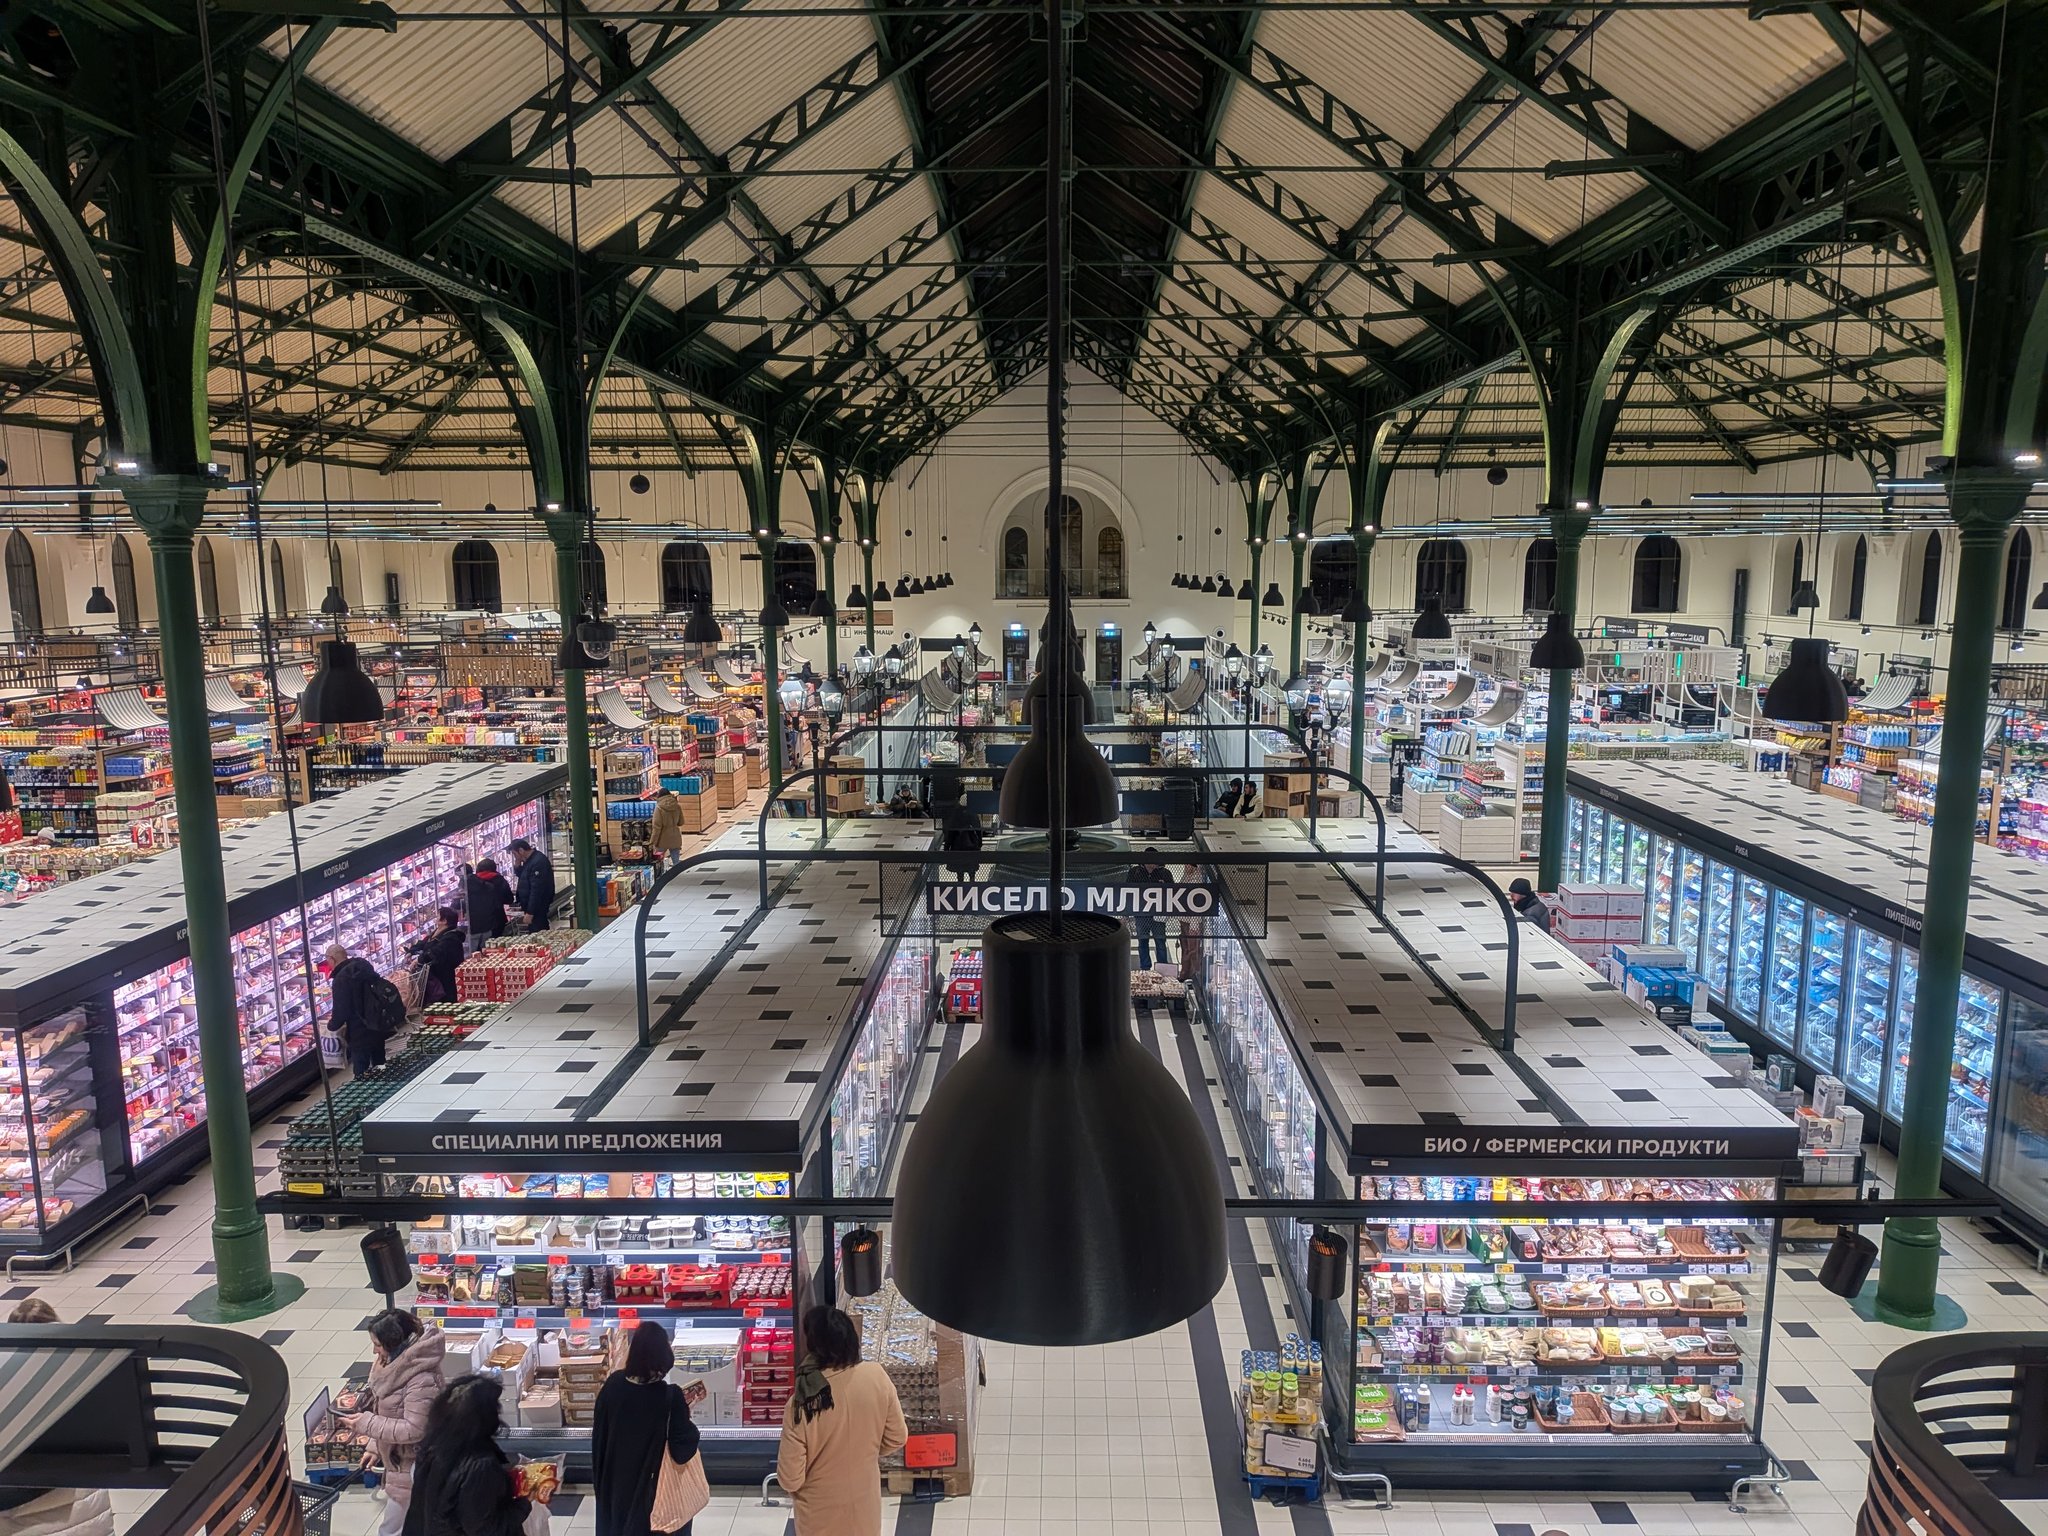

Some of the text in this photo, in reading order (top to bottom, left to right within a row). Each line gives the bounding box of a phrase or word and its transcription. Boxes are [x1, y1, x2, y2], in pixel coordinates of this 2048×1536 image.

[323, 860, 350, 879] КОЛБАСИ
[933, 886, 1213, 913] КИСЕЛО МЛЯКО
[1884, 907, 1923, 931] ПИЛЕШКО
[432, 1133, 722, 1152] СПЕЦИАЛНИ ПРЕДЛОЖЕНИЯ
[1424, 1137, 1467, 1153] БИО
[1485, 1137, 1612, 1155] ФЕРМЕРСКИ
[1617, 1138, 1730, 1157] ПРОДУКТИ
